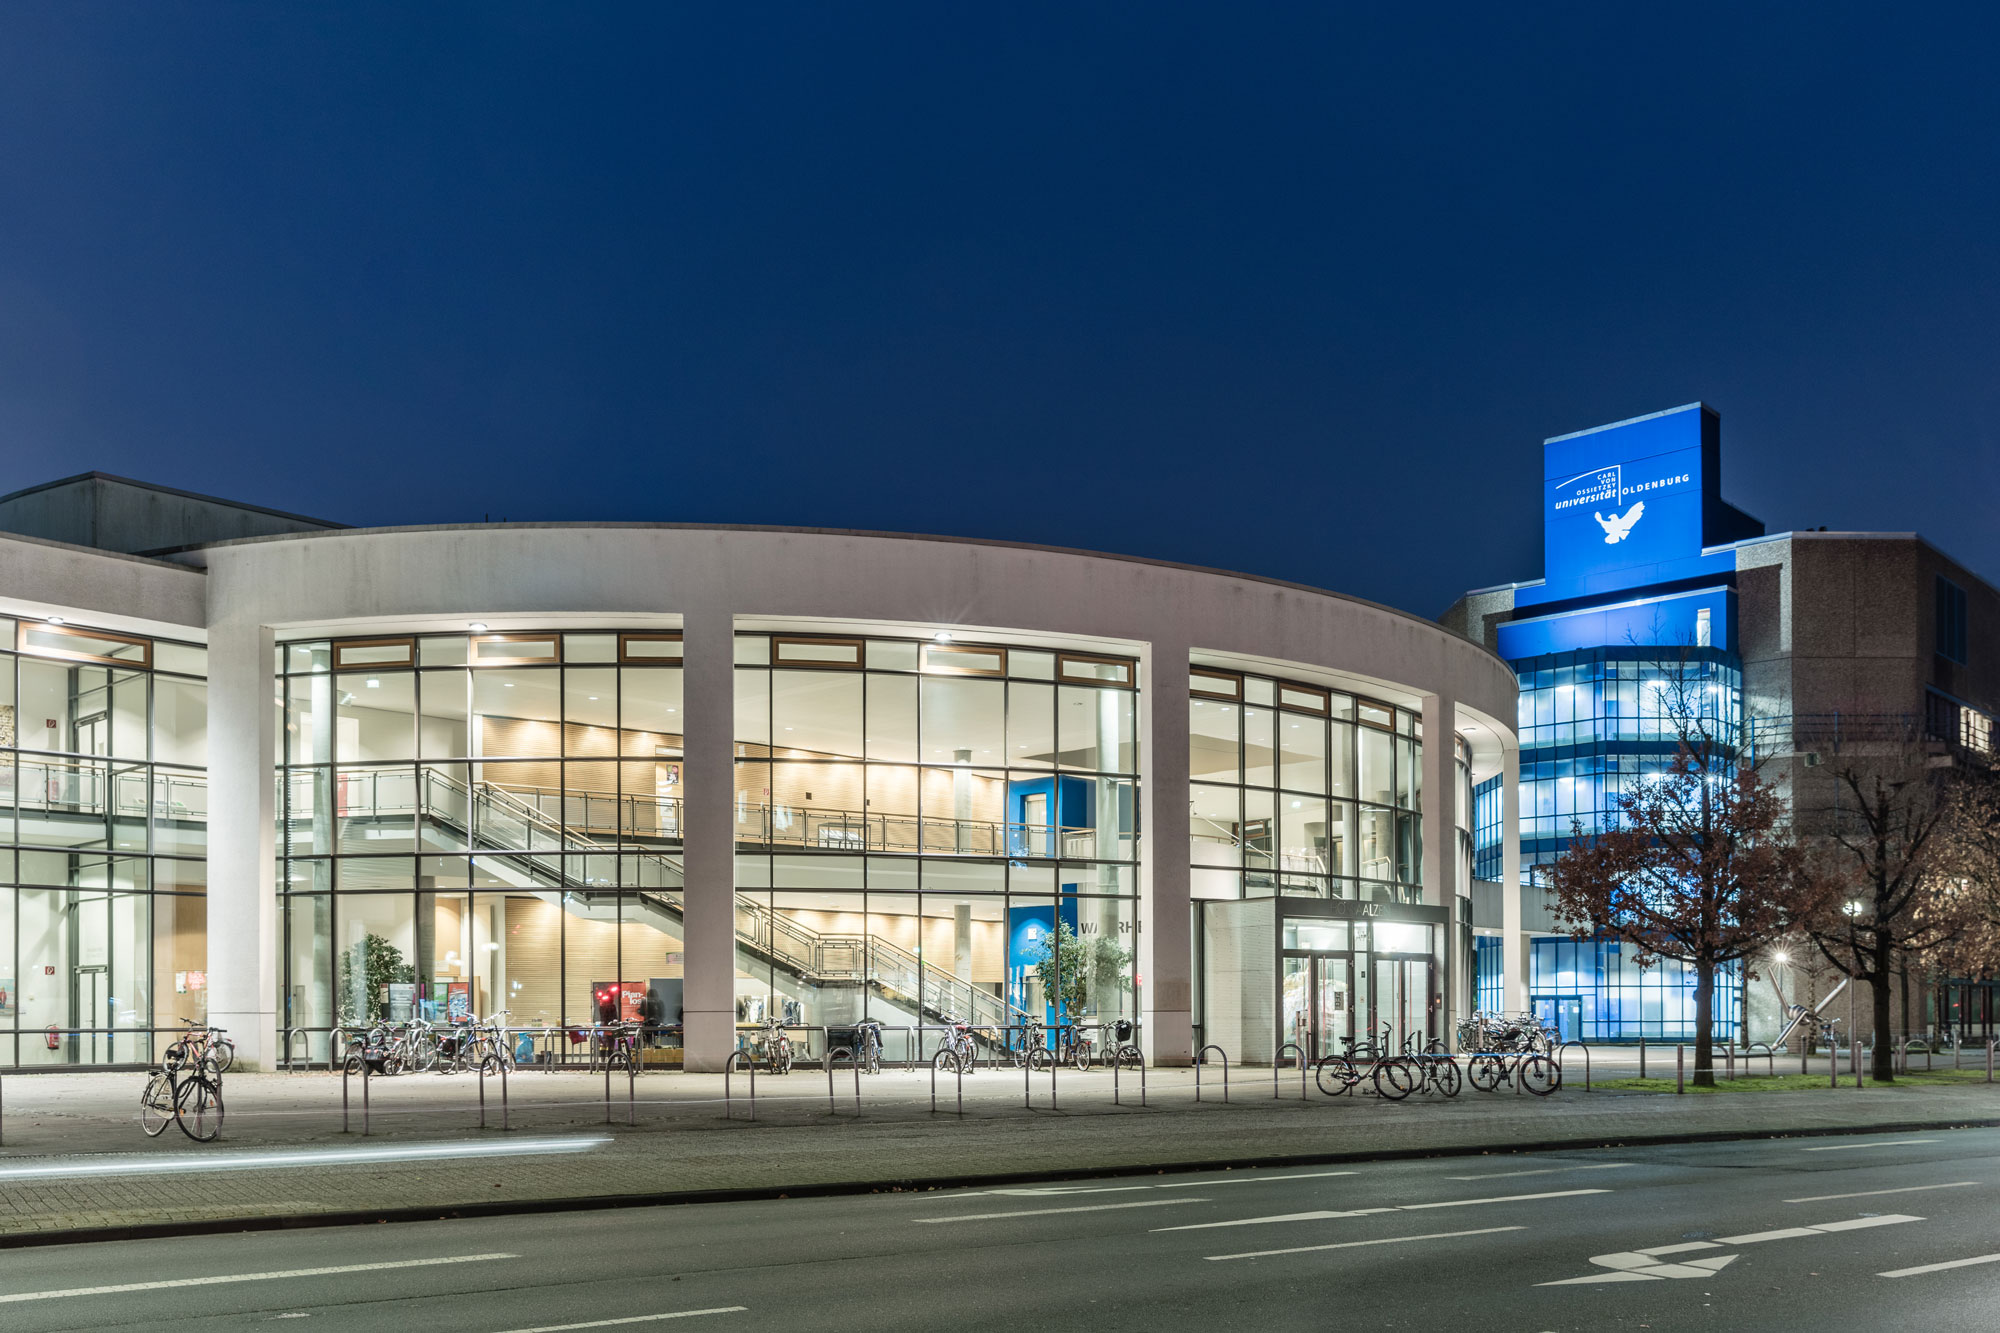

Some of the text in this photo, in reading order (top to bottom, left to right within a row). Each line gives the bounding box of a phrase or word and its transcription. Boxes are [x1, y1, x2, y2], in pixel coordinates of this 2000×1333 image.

[1597, 472, 1616, 480] CARL
[1601, 477, 1616, 485] VON
[1576, 483, 1616, 496] OSSIETZKY
[1622, 474, 1690, 495] OLDENBURG
[1555, 489, 1617, 510] universität
